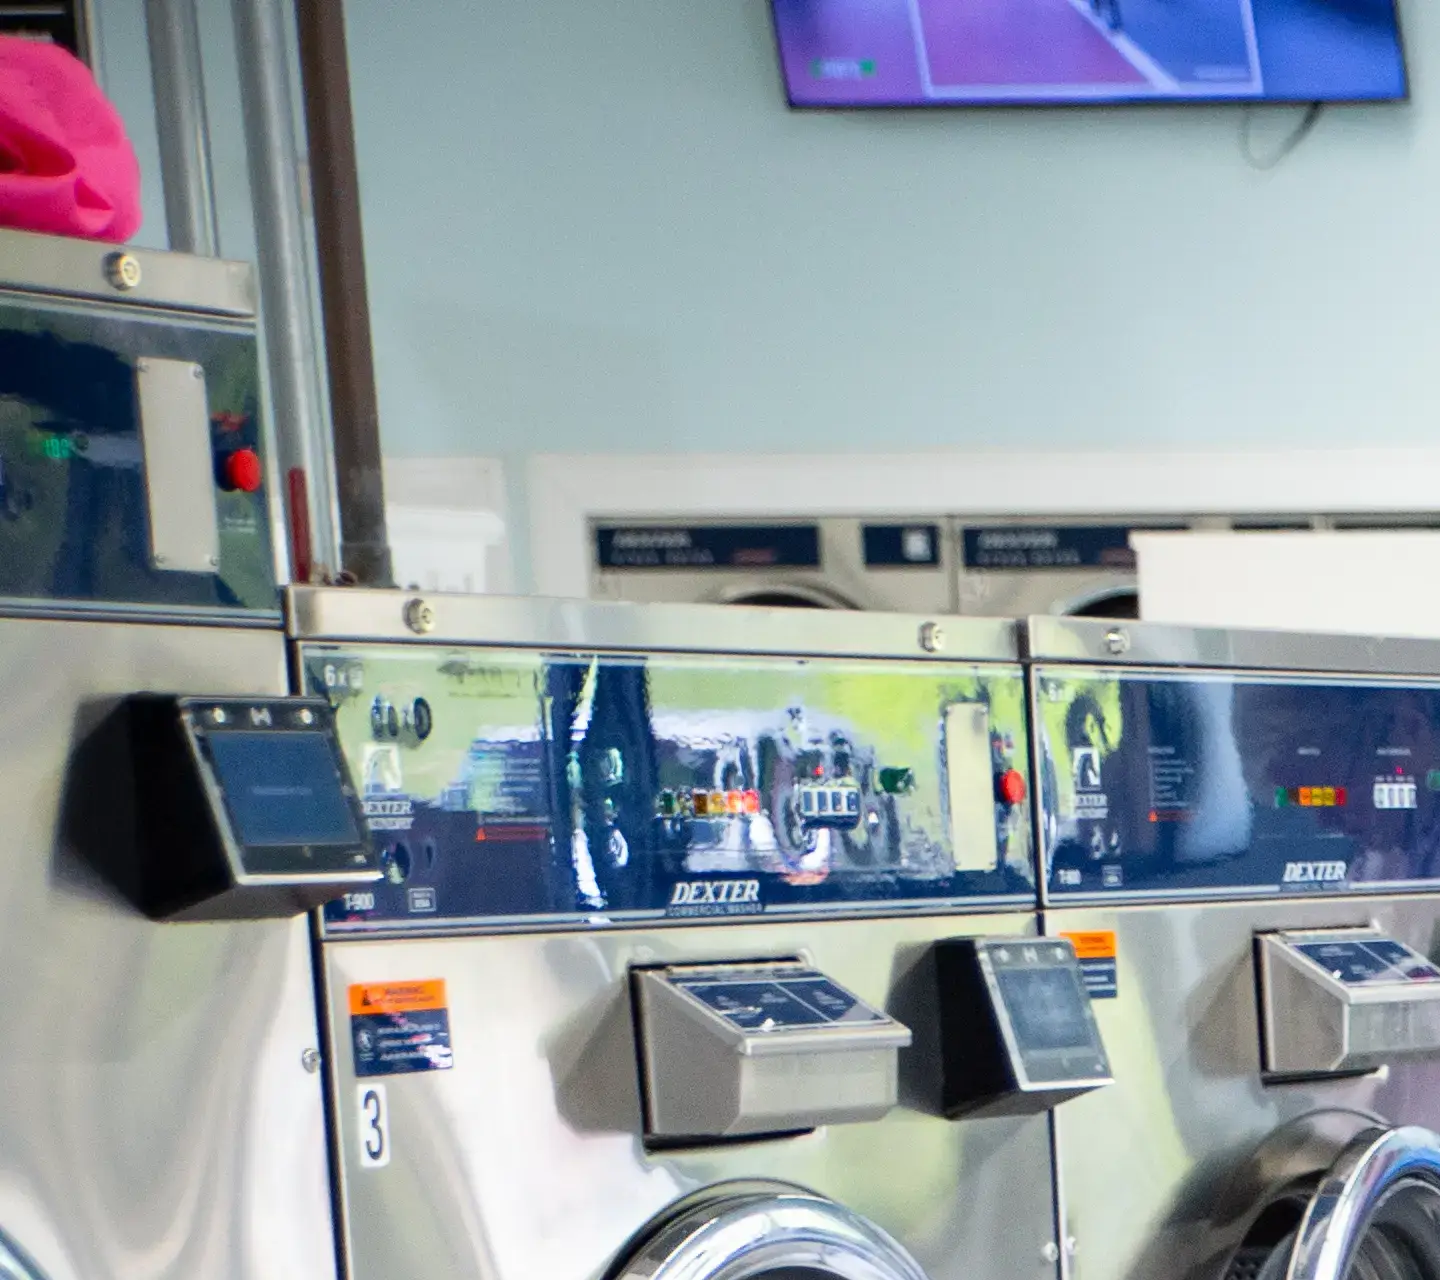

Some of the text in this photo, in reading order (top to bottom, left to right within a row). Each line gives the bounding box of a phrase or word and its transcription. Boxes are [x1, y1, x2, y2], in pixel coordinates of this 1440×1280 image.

[1283, 860, 1346, 883] DEXTER
[671, 880, 759, 904] DEXTER
[363, 1090, 384, 1160] 3
